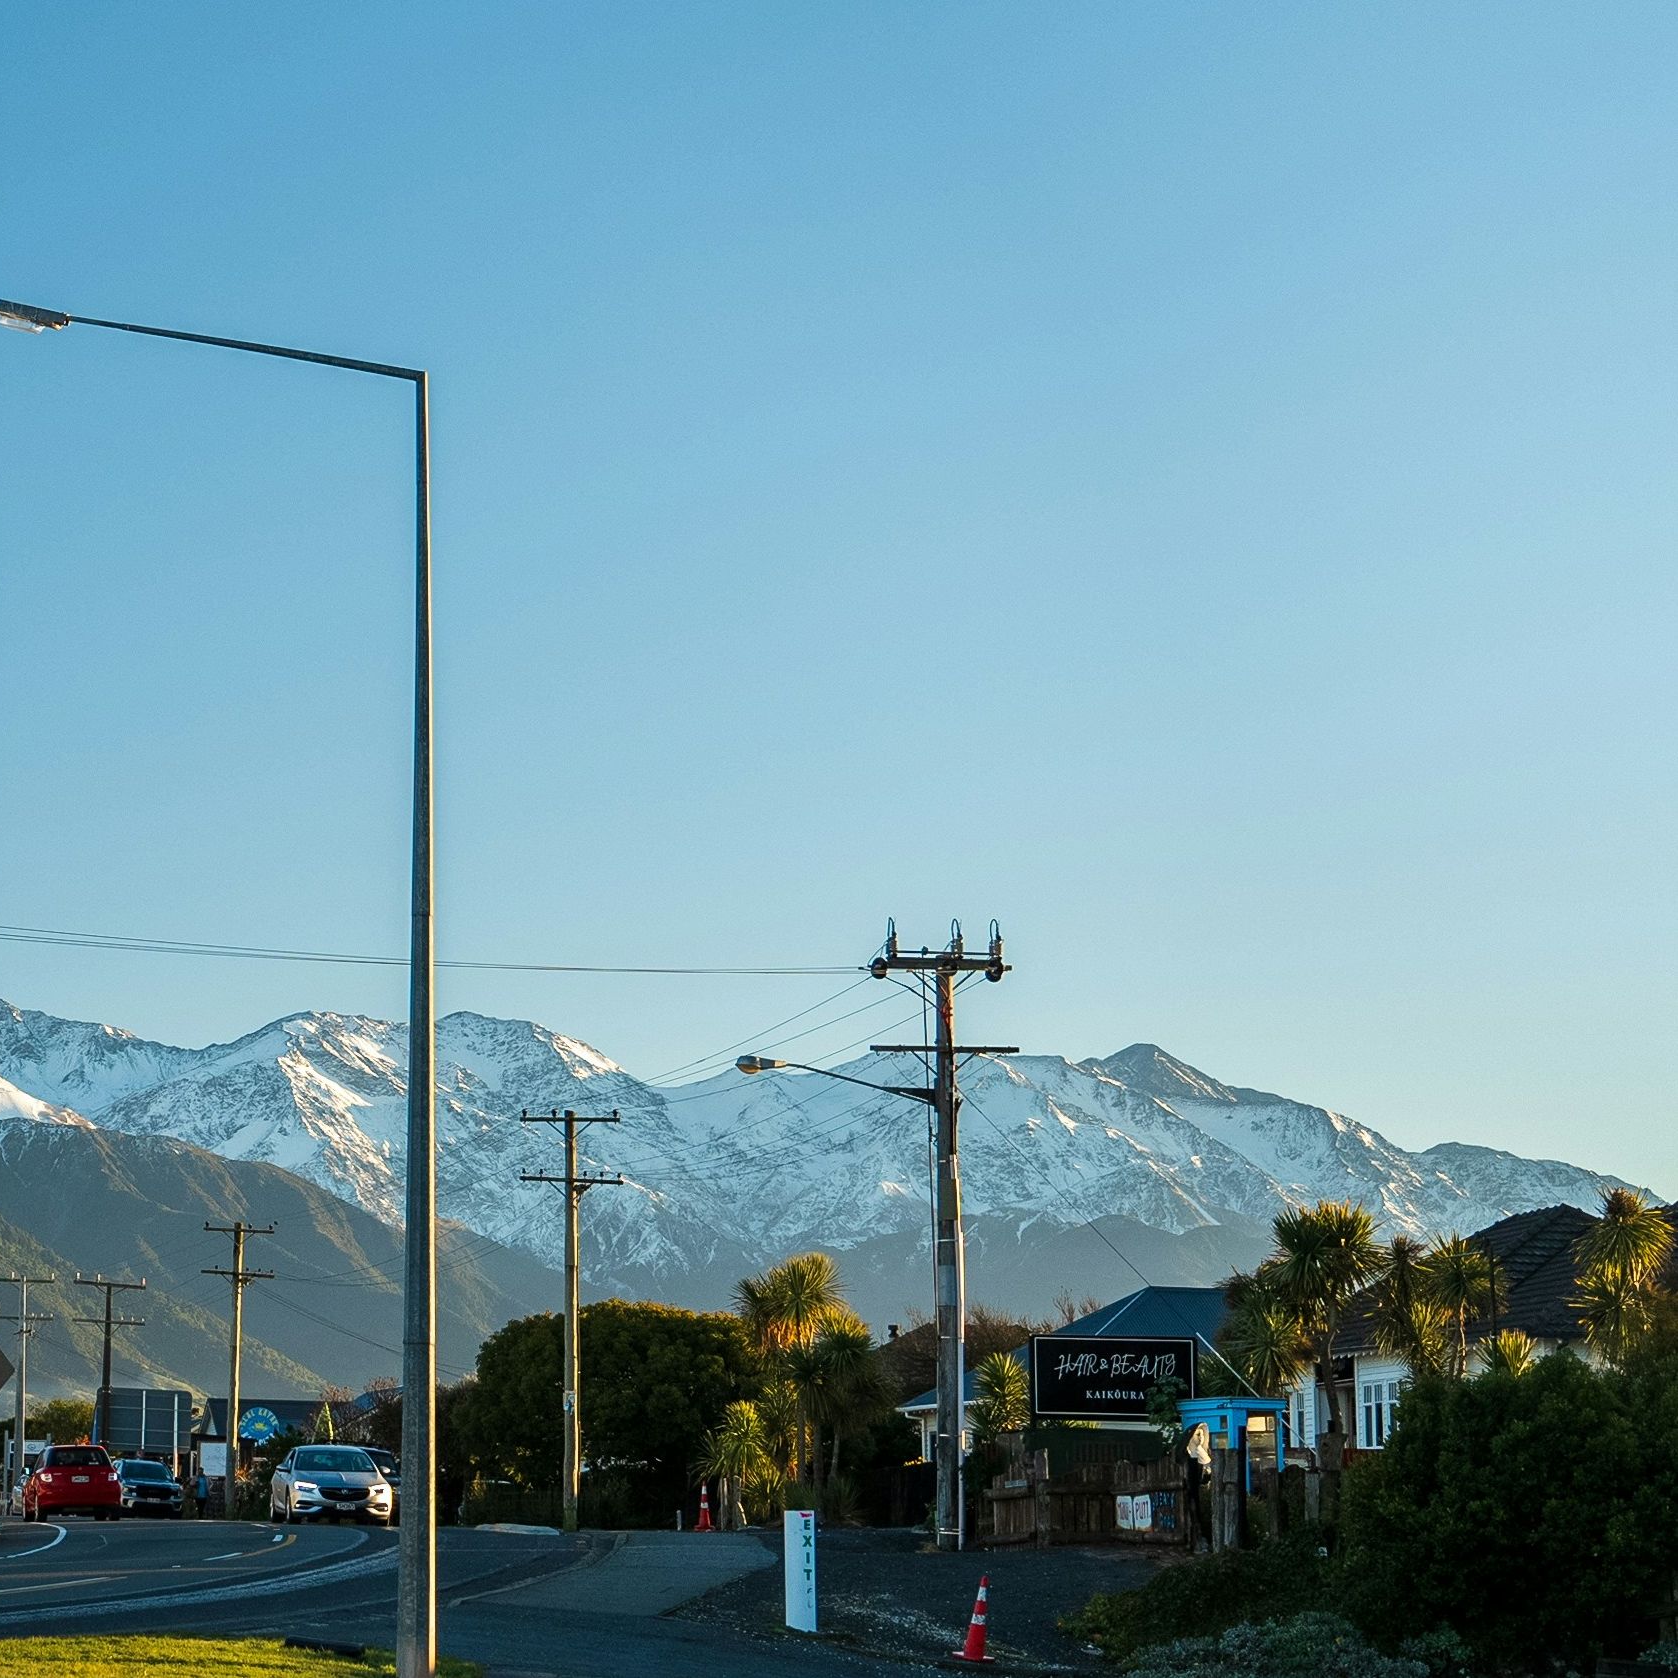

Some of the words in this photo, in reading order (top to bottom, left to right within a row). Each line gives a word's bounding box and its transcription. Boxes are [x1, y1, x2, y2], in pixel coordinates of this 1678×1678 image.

[1054, 1353, 1099, 1380] HAIR
[1100, 1358, 1108, 1370] &
[1110, 1353, 1176, 1379] BEAUTY
[802, 1519, 812, 1581] EXIT
